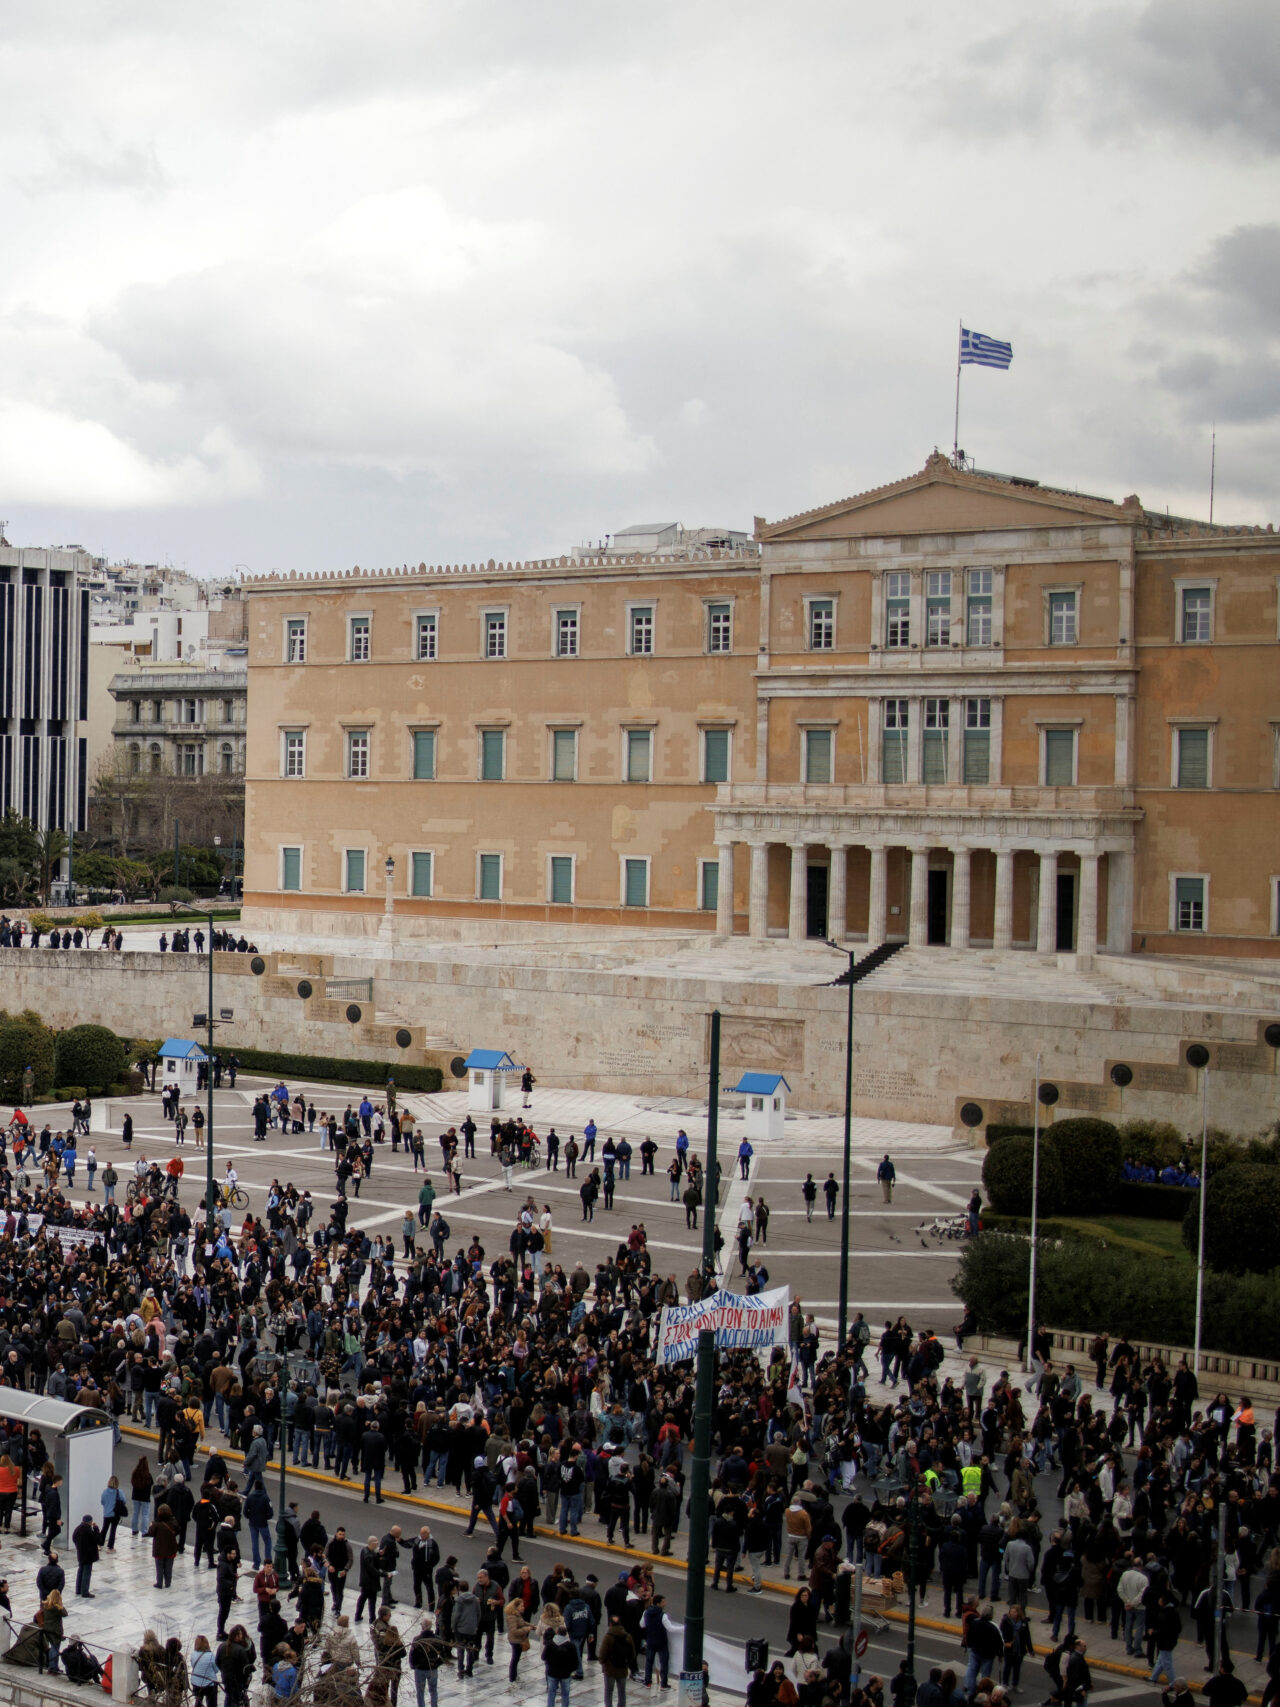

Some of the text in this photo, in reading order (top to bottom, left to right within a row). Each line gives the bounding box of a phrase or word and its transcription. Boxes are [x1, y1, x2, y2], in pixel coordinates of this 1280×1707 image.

[663, 1322, 694, 1345] ΣΤΩΝ
[746, 1309, 758, 1330] ΤΟ
[758, 1306, 784, 1330] ΑΙΜΑ!
